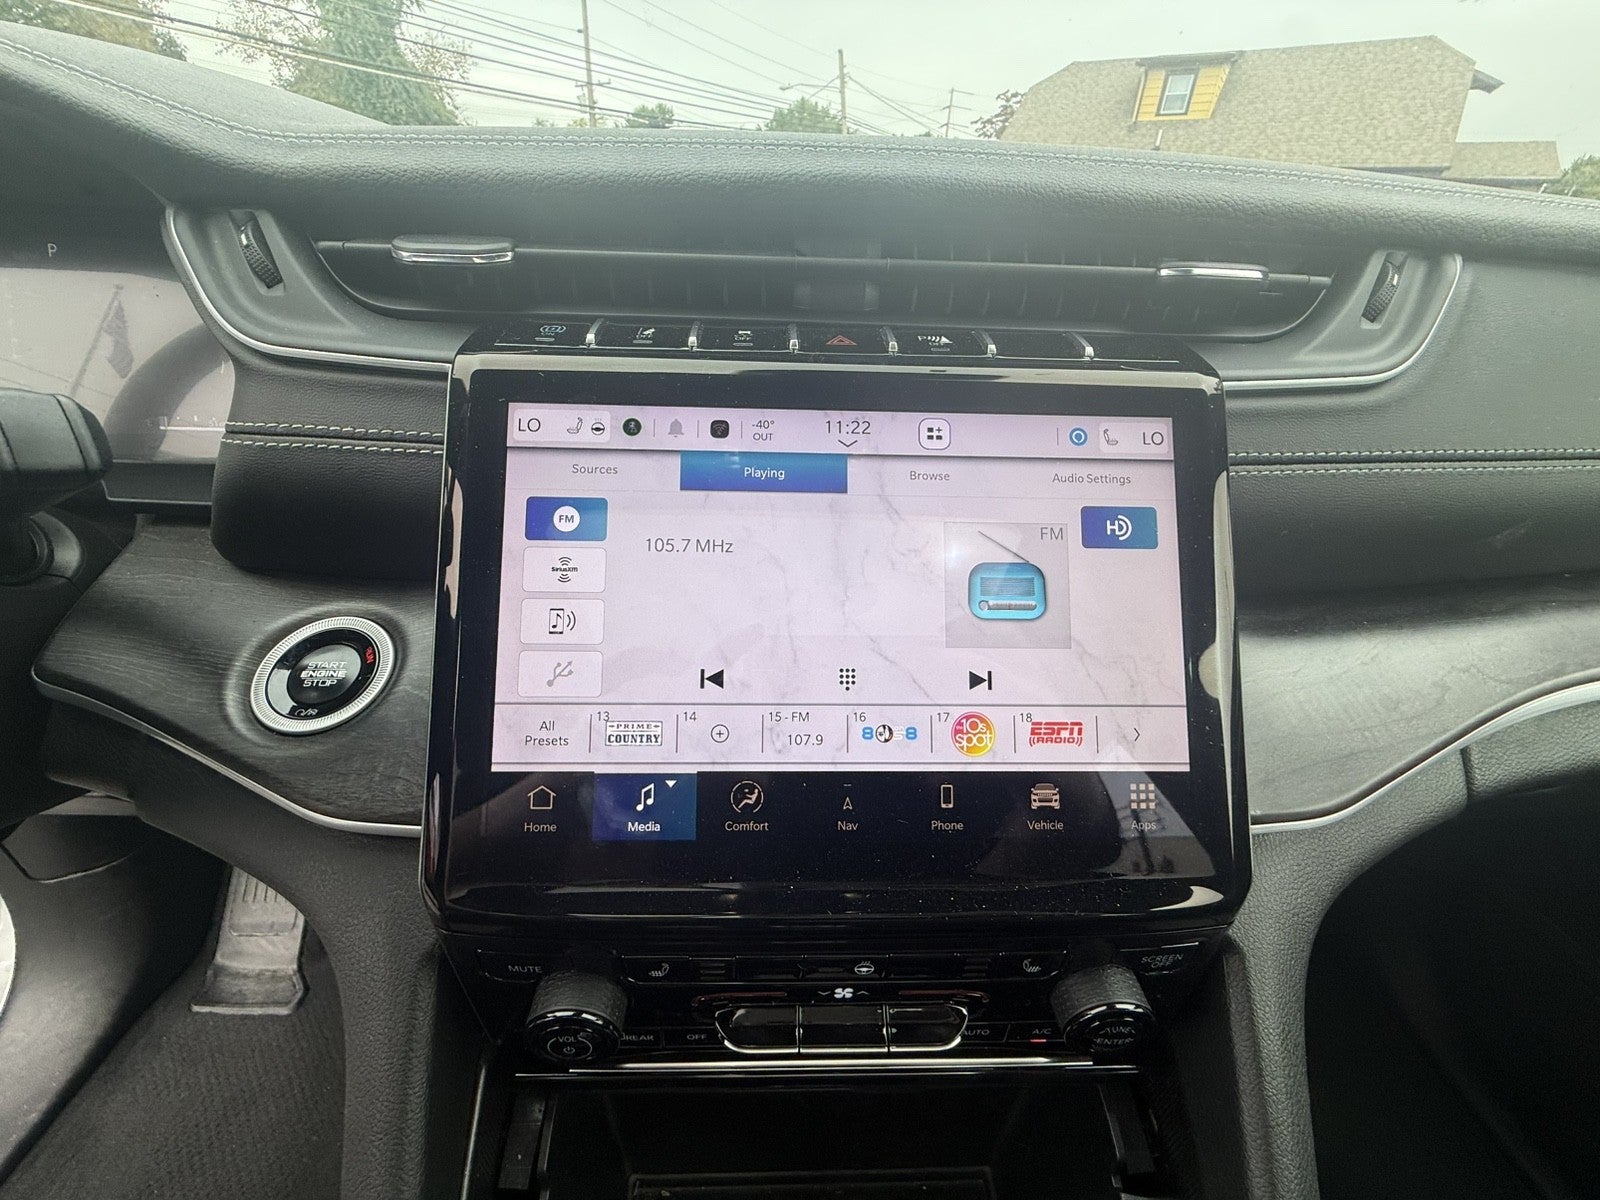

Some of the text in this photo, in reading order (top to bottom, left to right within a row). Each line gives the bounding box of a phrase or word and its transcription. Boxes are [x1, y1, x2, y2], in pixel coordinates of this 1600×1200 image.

[47, 243, 57, 257] P
[518, 417, 541, 434] LO
[751, 419, 775, 431] -40°
[826, 420, 871, 436] 11:22
[752, 432, 774, 442] OUT
[1142, 431, 1165, 446] LO
[571, 463, 619, 476] Sources
[743, 466, 786, 481] Playing
[909, 470, 950, 482] Browse
[1052, 473, 1132, 487] Audio Settings
[558, 514, 575, 525] FM
[1040, 527, 1064, 541] FM
[645, 538, 734, 554] 105.7 MHz
[307, 661, 348, 669] START
[300, 670, 347, 678] ENGINE
[303, 679, 338, 687] STOP
[597, 711, 610, 722] 13
[683, 711, 697, 722] 14
[768, 711, 782, 723] 15
[791, 711, 810, 723] FM
[853, 712, 867, 722] 16
[937, 712, 950, 722] 17
[1020, 712, 1033, 723] 18
[539, 720, 555, 732] All
[1030, 721, 1083, 736] ESPN
[524, 735, 569, 747] Presets
[607, 733, 661, 745] COUNTRY
[787, 734, 824, 746] 107.9
[955, 731, 992, 752] spot
[524, 821, 557, 832] Home
[627, 821, 661, 832] Media
[724, 820, 769, 832] Comfort
[837, 820, 858, 831] Nav
[930, 819, 964, 831] Phone
[1027, 819, 1064, 831] Vehicle
[1130, 820, 1157, 834] Apps
[1140, 954, 1184, 963] SCREEN
[507, 964, 543, 974] MUTE
[1031, 1027, 1052, 1035] A/C
[557, 1035, 578, 1043] VOL
[686, 1033, 708, 1042] OFF
